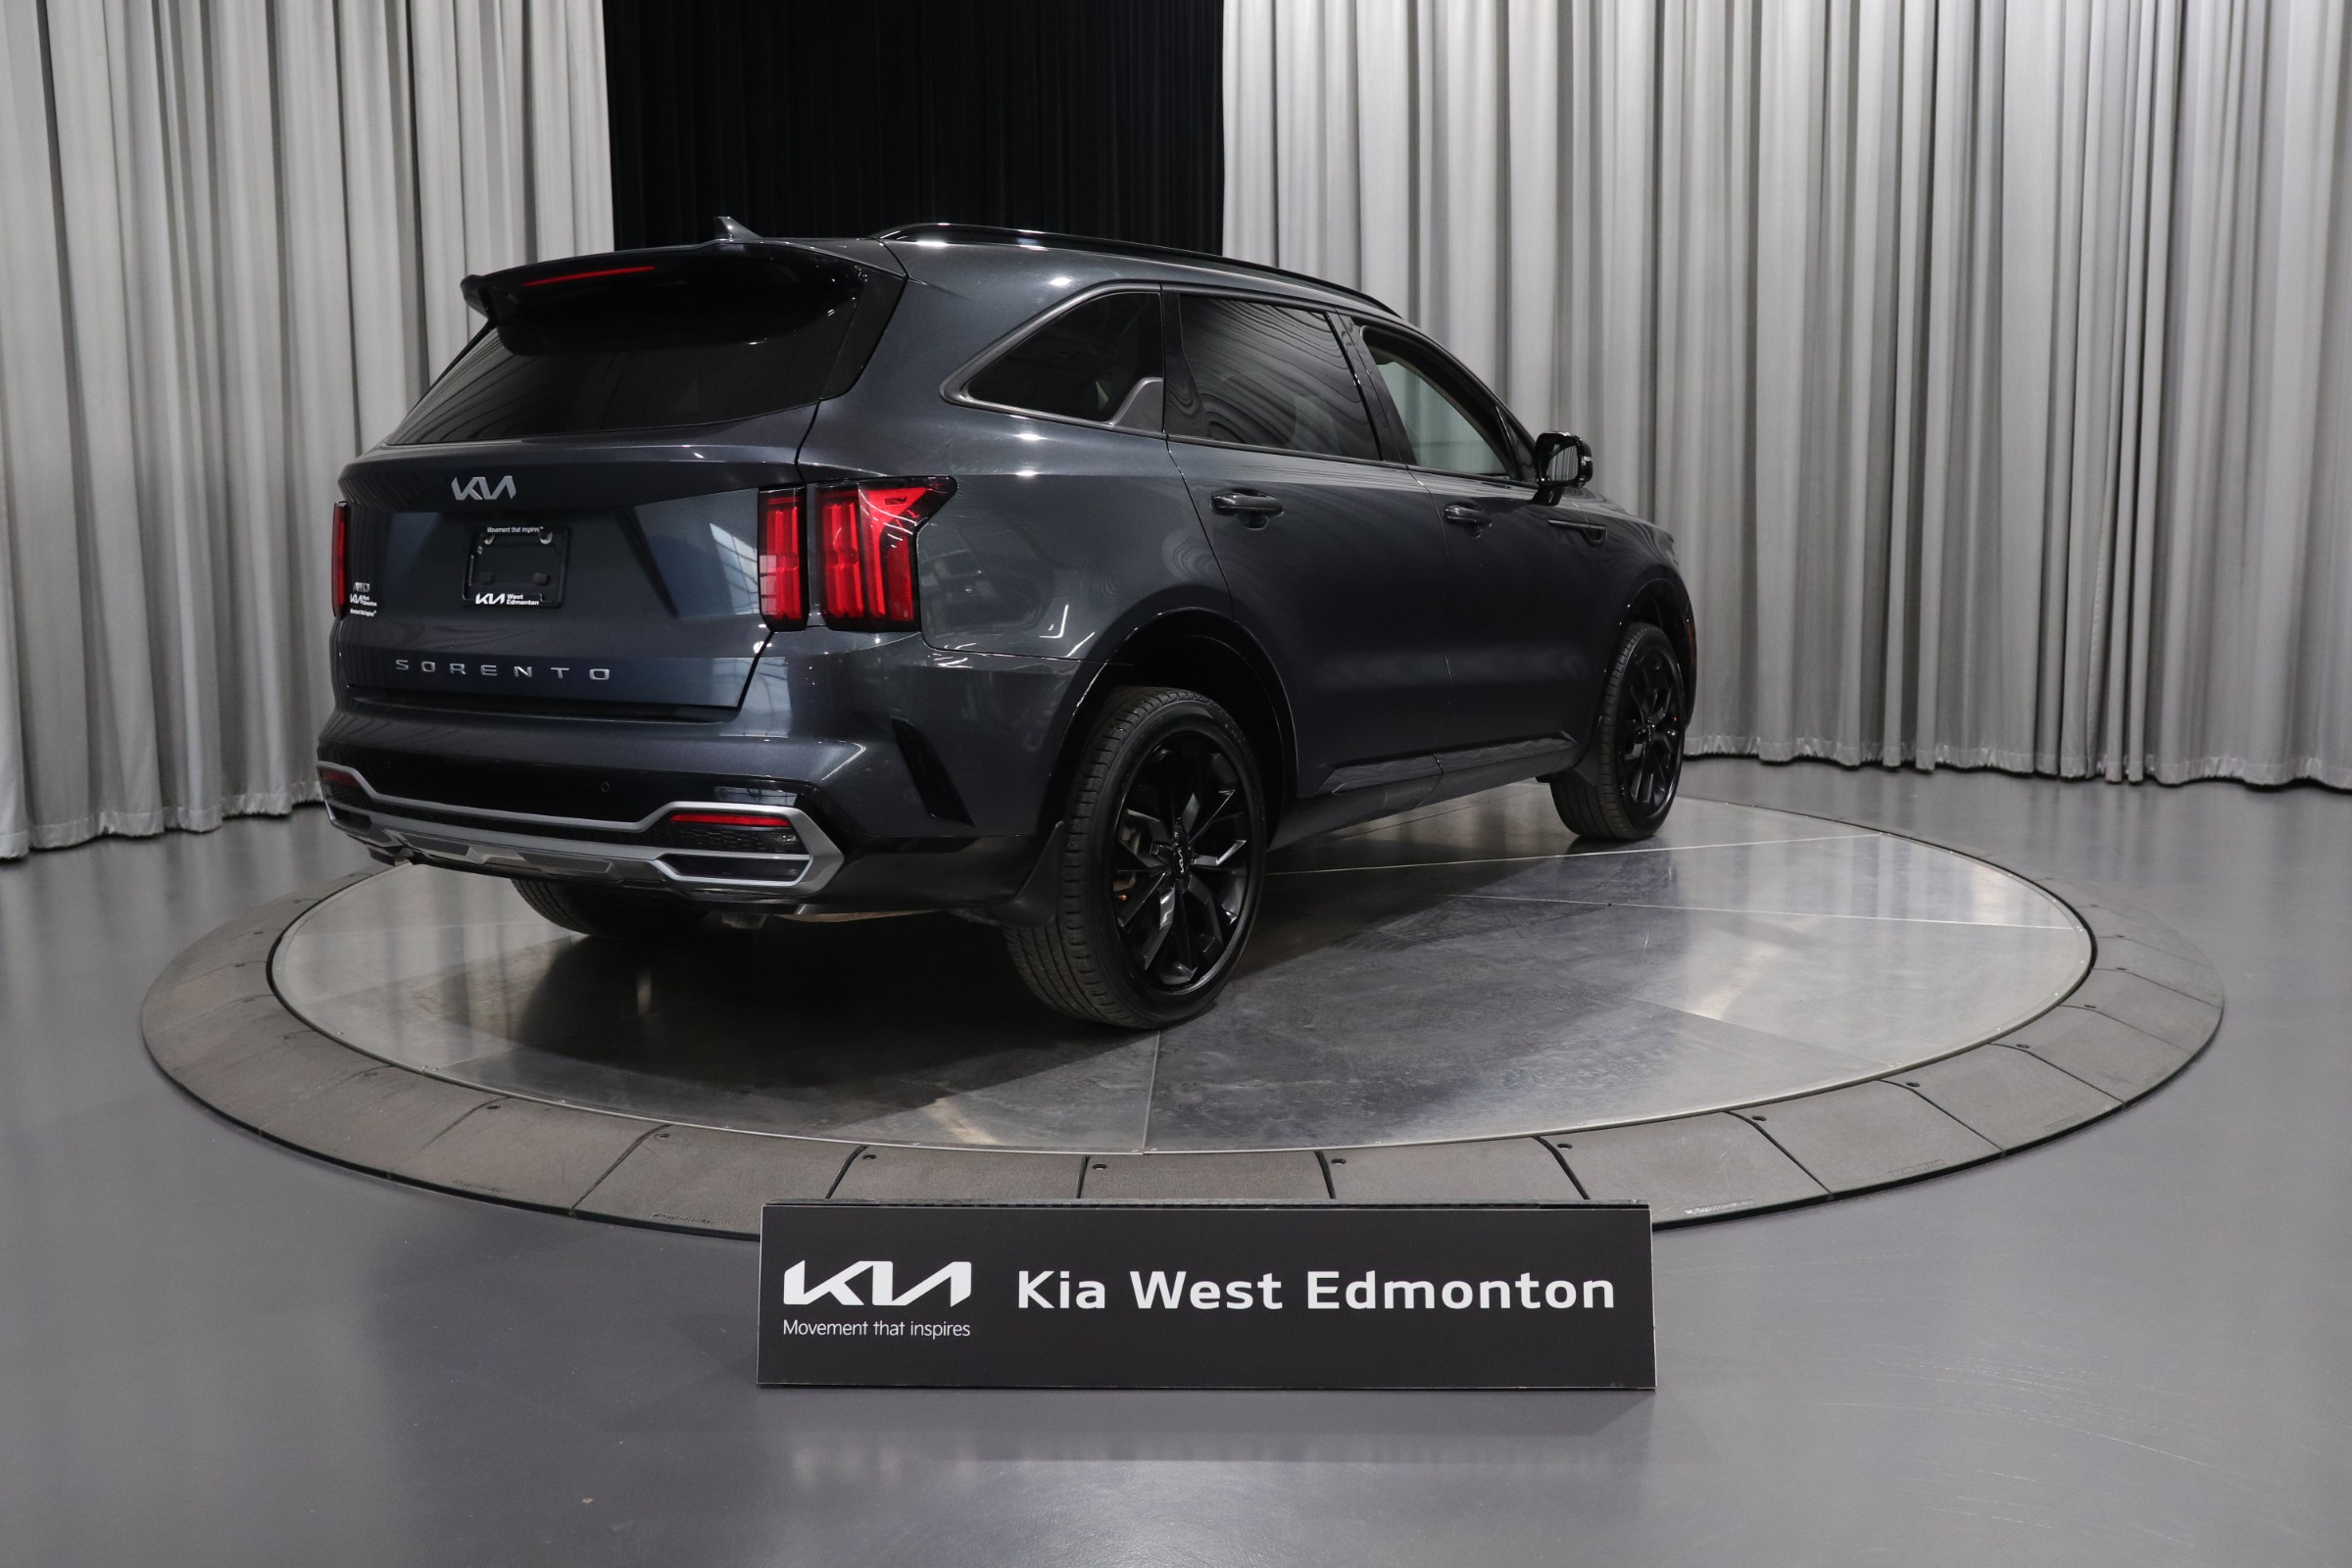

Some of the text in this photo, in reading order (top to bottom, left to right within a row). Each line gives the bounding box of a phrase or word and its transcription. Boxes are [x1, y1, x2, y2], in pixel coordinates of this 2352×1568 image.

[451, 475, 517, 501] KIA
[350, 593, 363, 605] KIA
[475, 593, 506, 605] KIA
[395, 660, 610, 681] SORENTO
[783, 1259, 972, 1307] KIA
[1018, 1269, 1615, 1311] Kia West Edmonton
[783, 1319, 971, 1341] Movement that inspires
